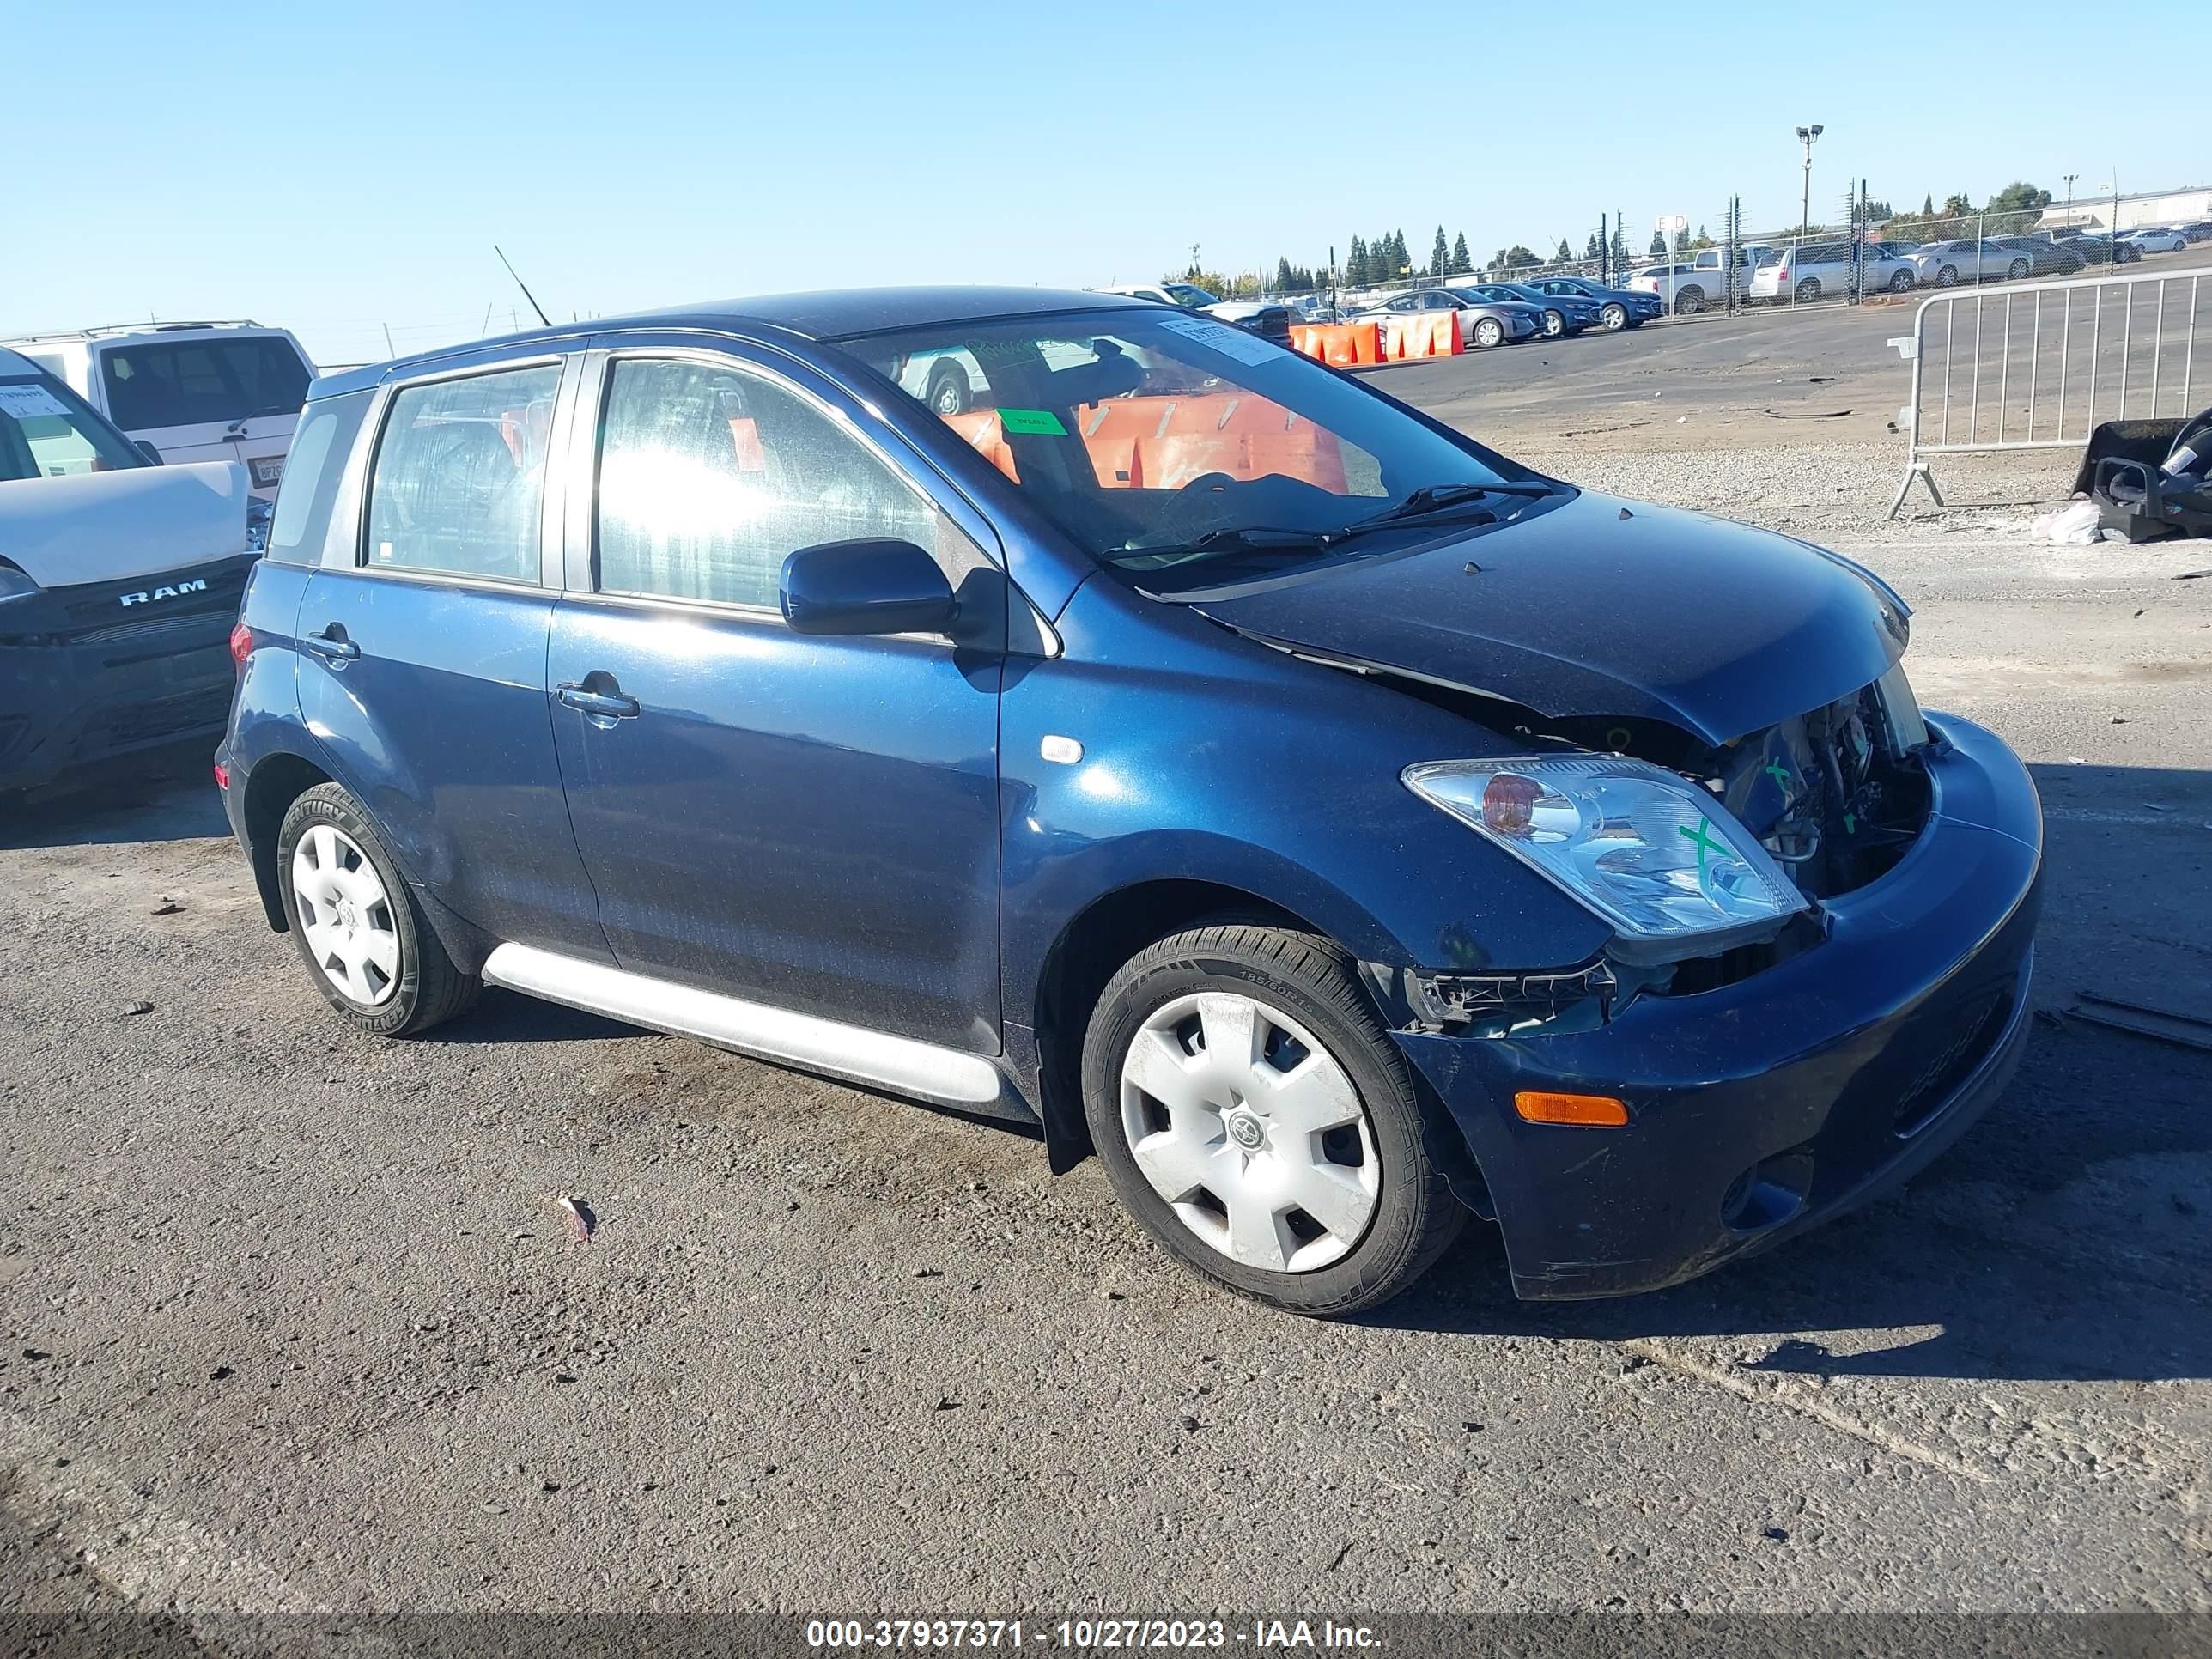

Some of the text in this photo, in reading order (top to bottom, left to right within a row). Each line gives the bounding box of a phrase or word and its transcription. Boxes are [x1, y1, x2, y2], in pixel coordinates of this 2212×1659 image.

[259, 465, 282, 478] 8PZG
[119, 579, 207, 607] RAM
[1239, 969, 1314, 1014] 185/60R15
